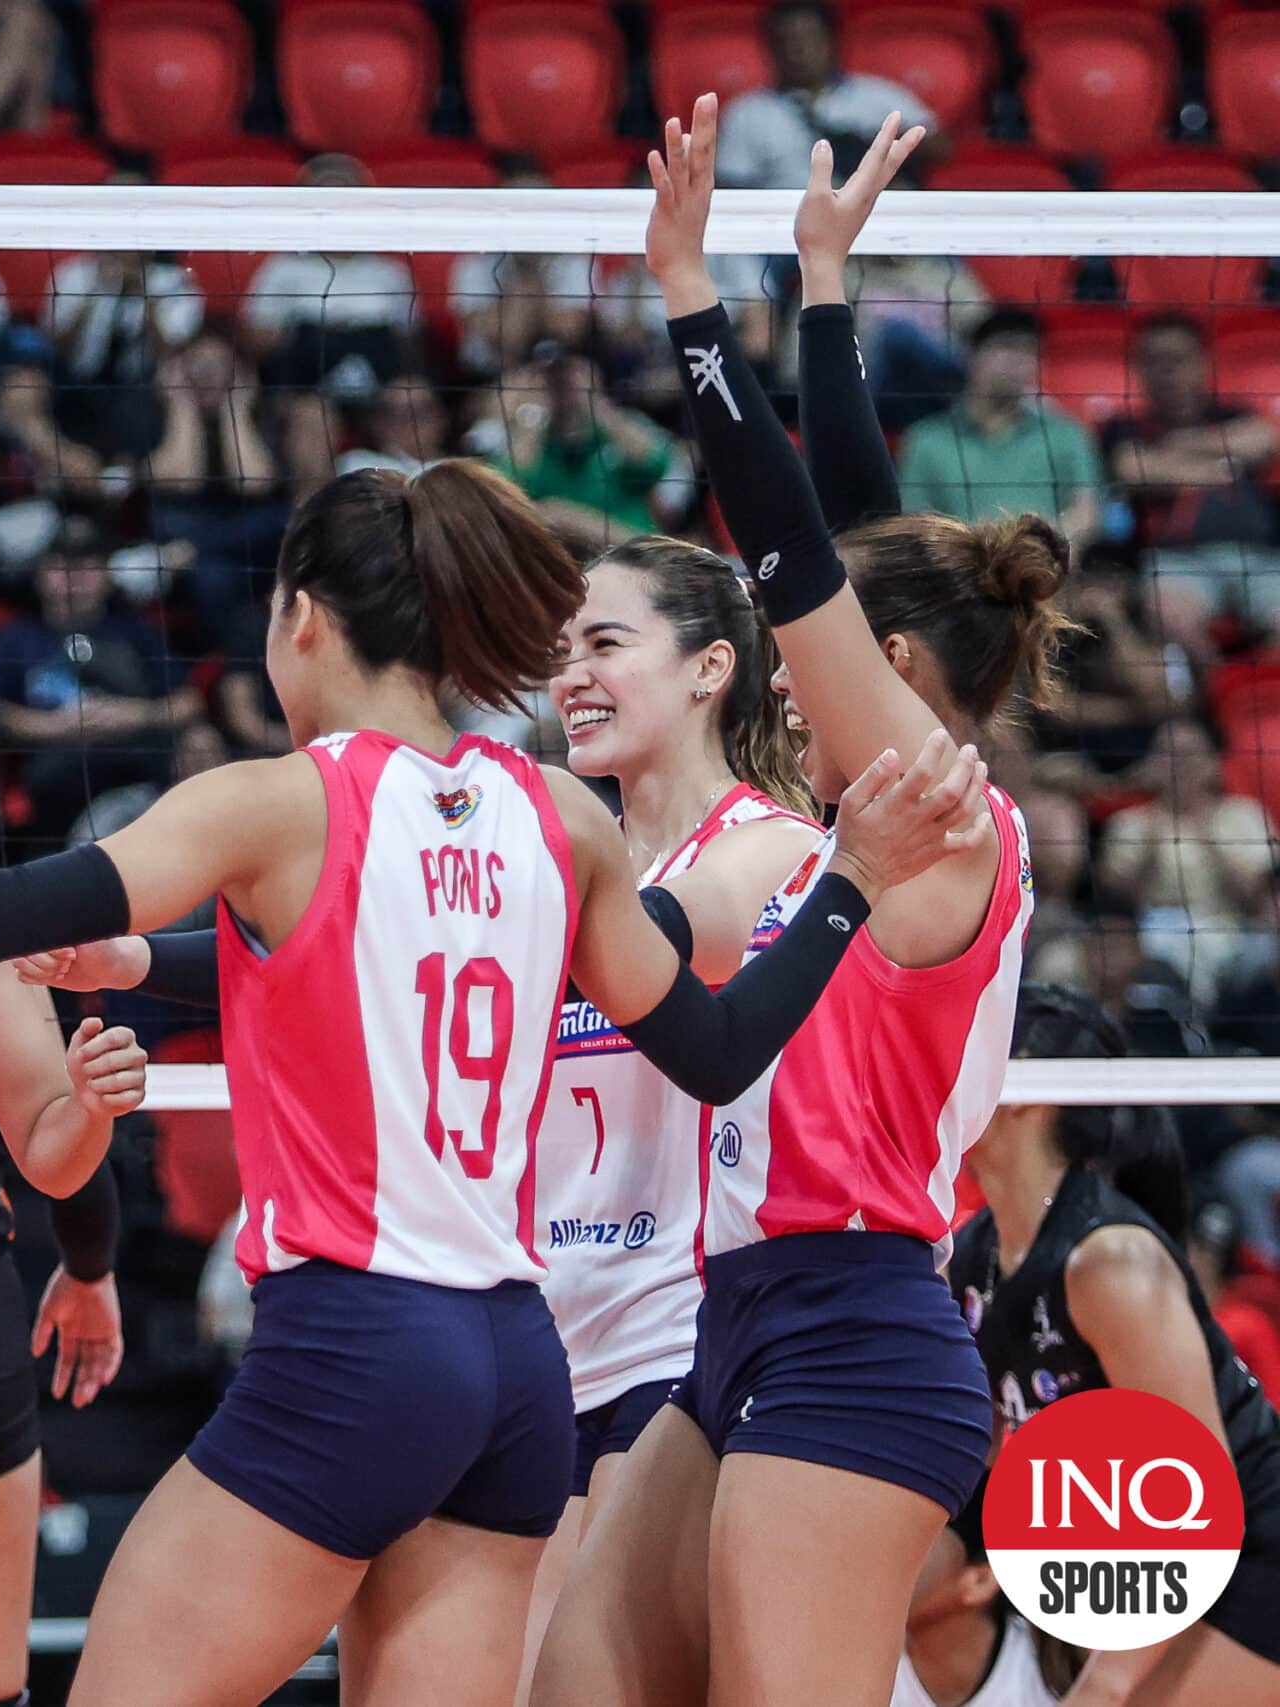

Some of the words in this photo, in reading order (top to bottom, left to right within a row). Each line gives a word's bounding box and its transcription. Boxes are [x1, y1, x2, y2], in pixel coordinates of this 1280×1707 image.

[420, 844, 504, 919] PONS
[415, 952, 513, 1179] 19
[571, 1087, 604, 1175] 7
[549, 1218, 622, 1249] Allianz
